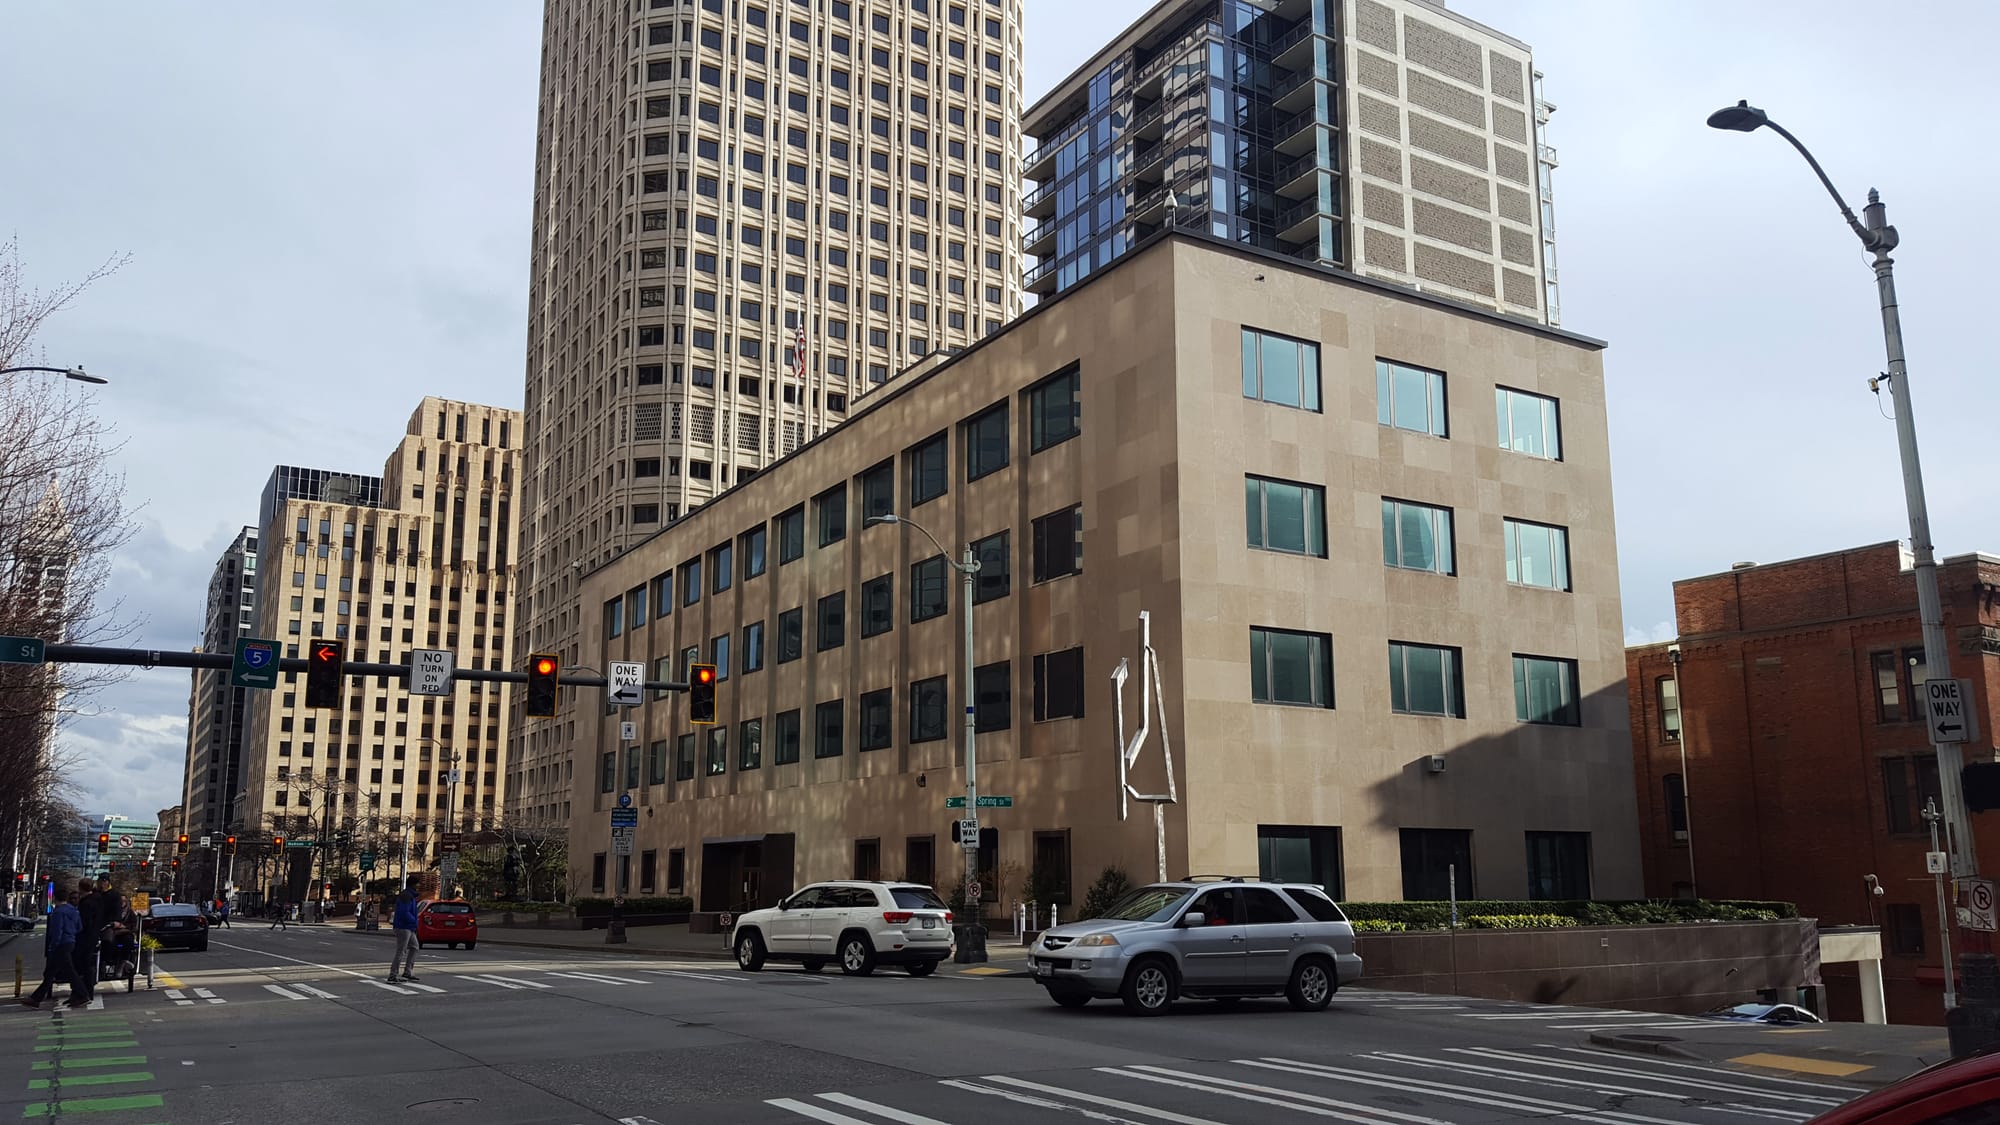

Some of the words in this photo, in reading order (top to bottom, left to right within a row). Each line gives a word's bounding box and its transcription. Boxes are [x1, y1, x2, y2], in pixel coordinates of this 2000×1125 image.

[20, 645, 36, 657] St
[252, 651, 262, 664] 5
[423, 653, 442, 663] NO
[420, 664, 444, 673] TURN
[616, 665, 638, 676] ONE
[424, 674, 438, 683] ON
[615, 677, 638, 687] WAY
[421, 684, 440, 693] RED
[1930, 684, 1959, 699] ONE
[1932, 701, 1960, 717] WAY
[977, 796, 997, 807] Spring
[961, 821, 977, 829] ONE
[961, 829, 977, 837] WAY
